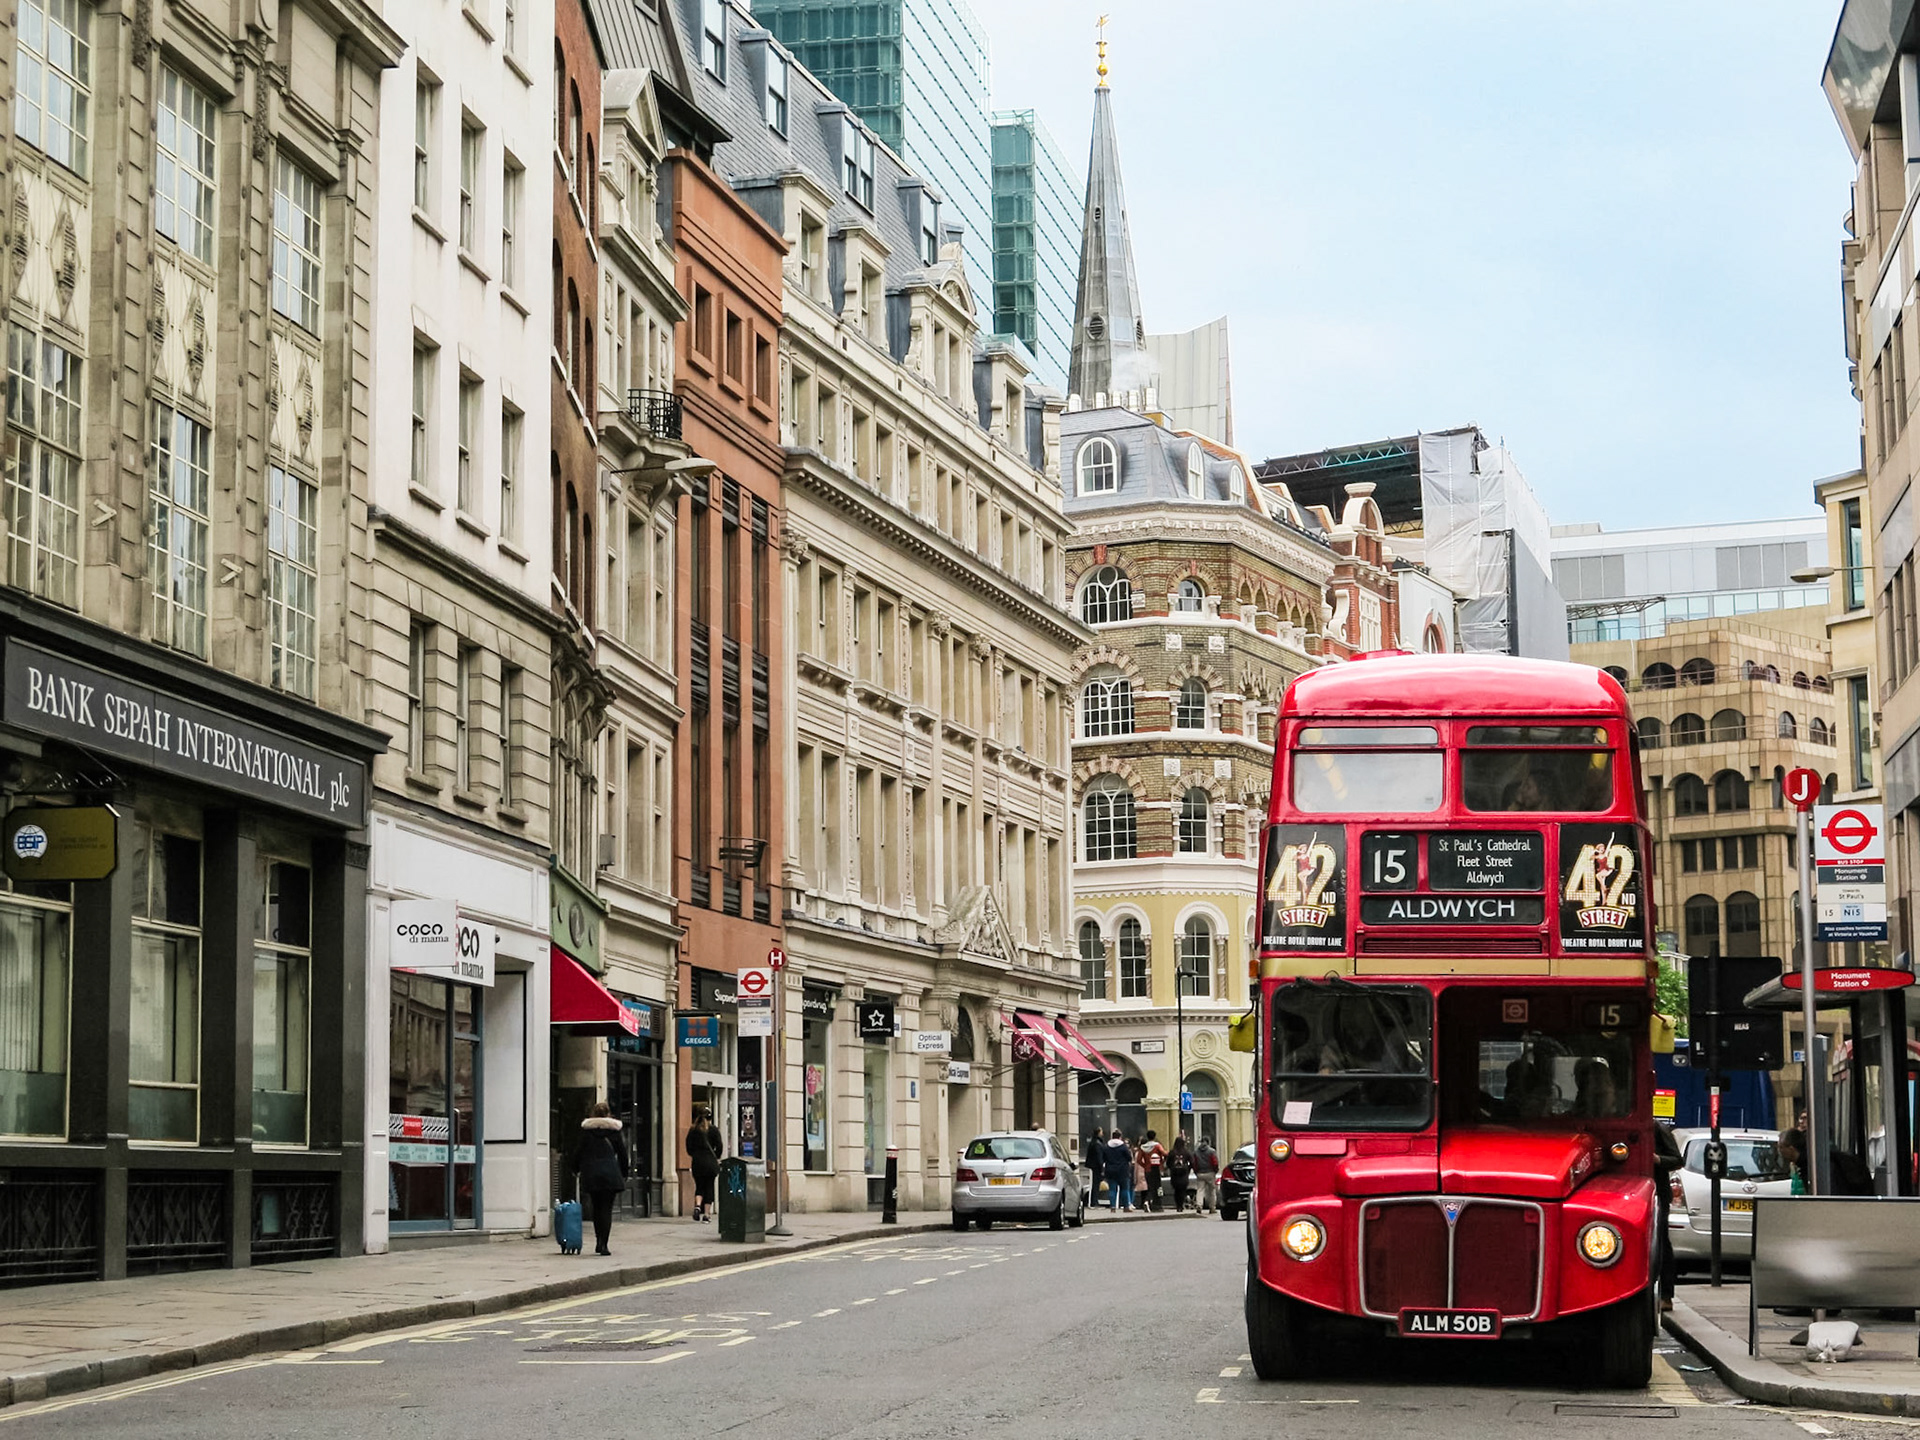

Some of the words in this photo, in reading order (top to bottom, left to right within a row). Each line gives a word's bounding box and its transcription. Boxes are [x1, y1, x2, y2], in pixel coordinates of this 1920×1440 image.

[27, 667, 95, 728] BANK
[104, 692, 171, 751] SEPAH
[176, 716, 325, 800] INTERNATIONAL
[330, 772, 350, 812] plc
[1792, 774, 1809, 801] J
[1438, 839, 1449, 852] St
[1453, 839, 1482, 852] Paul's
[1487, 839, 1532, 852] Cathedral
[1374, 849, 1407, 884] 15
[1457, 855, 1481, 868] Fleet
[1485, 855, 1513, 868] Street
[1267, 844, 1337, 906] 42
[1322, 891, 1336, 904] ND
[1466, 871, 1505, 887] Aldwych
[1564, 844, 1635, 907] 42
[1621, 892, 1636, 905] ND
[1281, 908, 1327, 926] STREET
[1387, 899, 1516, 919] ALDWYCH
[1825, 909, 1834, 917] 15
[1843, 908, 1861, 916] N15
[1580, 910, 1626, 927] STREET
[1263, 936, 1287, 945] THEATRE
[770, 951, 783, 966] H
[461, 962, 484, 979] mama
[1833, 980, 1860, 988] Station
[1600, 1005, 1622, 1026] 15
[918, 1033, 943, 1042] Optical
[917, 1042, 945, 1051] Express
[1410, 1315, 1449, 1332] ALM
[1452, 1315, 1492, 1332] 50B
